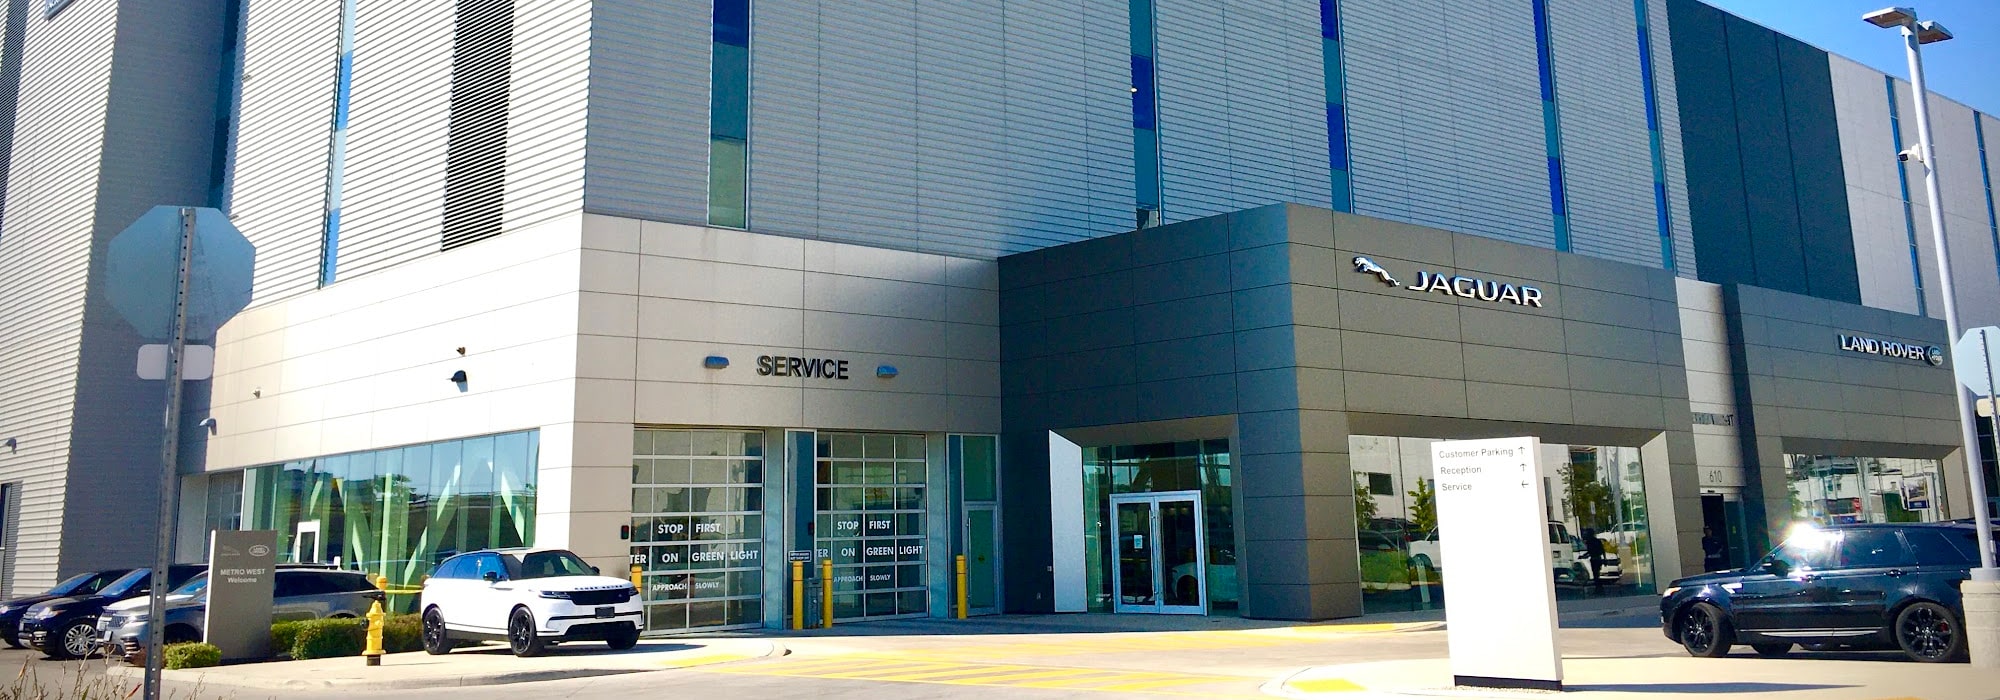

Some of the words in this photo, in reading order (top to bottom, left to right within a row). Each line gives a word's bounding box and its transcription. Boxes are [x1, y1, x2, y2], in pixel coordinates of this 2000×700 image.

[1405, 271, 1542, 308] JAGUAR
[1839, 334, 1879, 354] LAND
[1881, 341, 1925, 360] ROVER
[757, 355, 849, 380] SERVICE
[1439, 450, 1478, 459] Customer
[1481, 448, 1513, 457] Parking
[1440, 466, 1481, 475] Reception
[1709, 470, 1723, 483] 610
[1442, 483, 1472, 491] Service
[658, 523, 684, 534] STOP
[695, 523, 721, 533] FIRST
[837, 521, 859, 530] STOP
[869, 520, 891, 530] FIRST
[662, 553, 679, 563] ON
[691, 551, 724, 562] GREEN
[730, 550, 758, 560] LIGHT
[841, 547, 856, 557] ON
[866, 546, 894, 556] GREEN
[899, 545, 923, 555] LIGHT
[652, 583, 688, 591] APPROACH
[695, 581, 720, 589] SLOWLY
